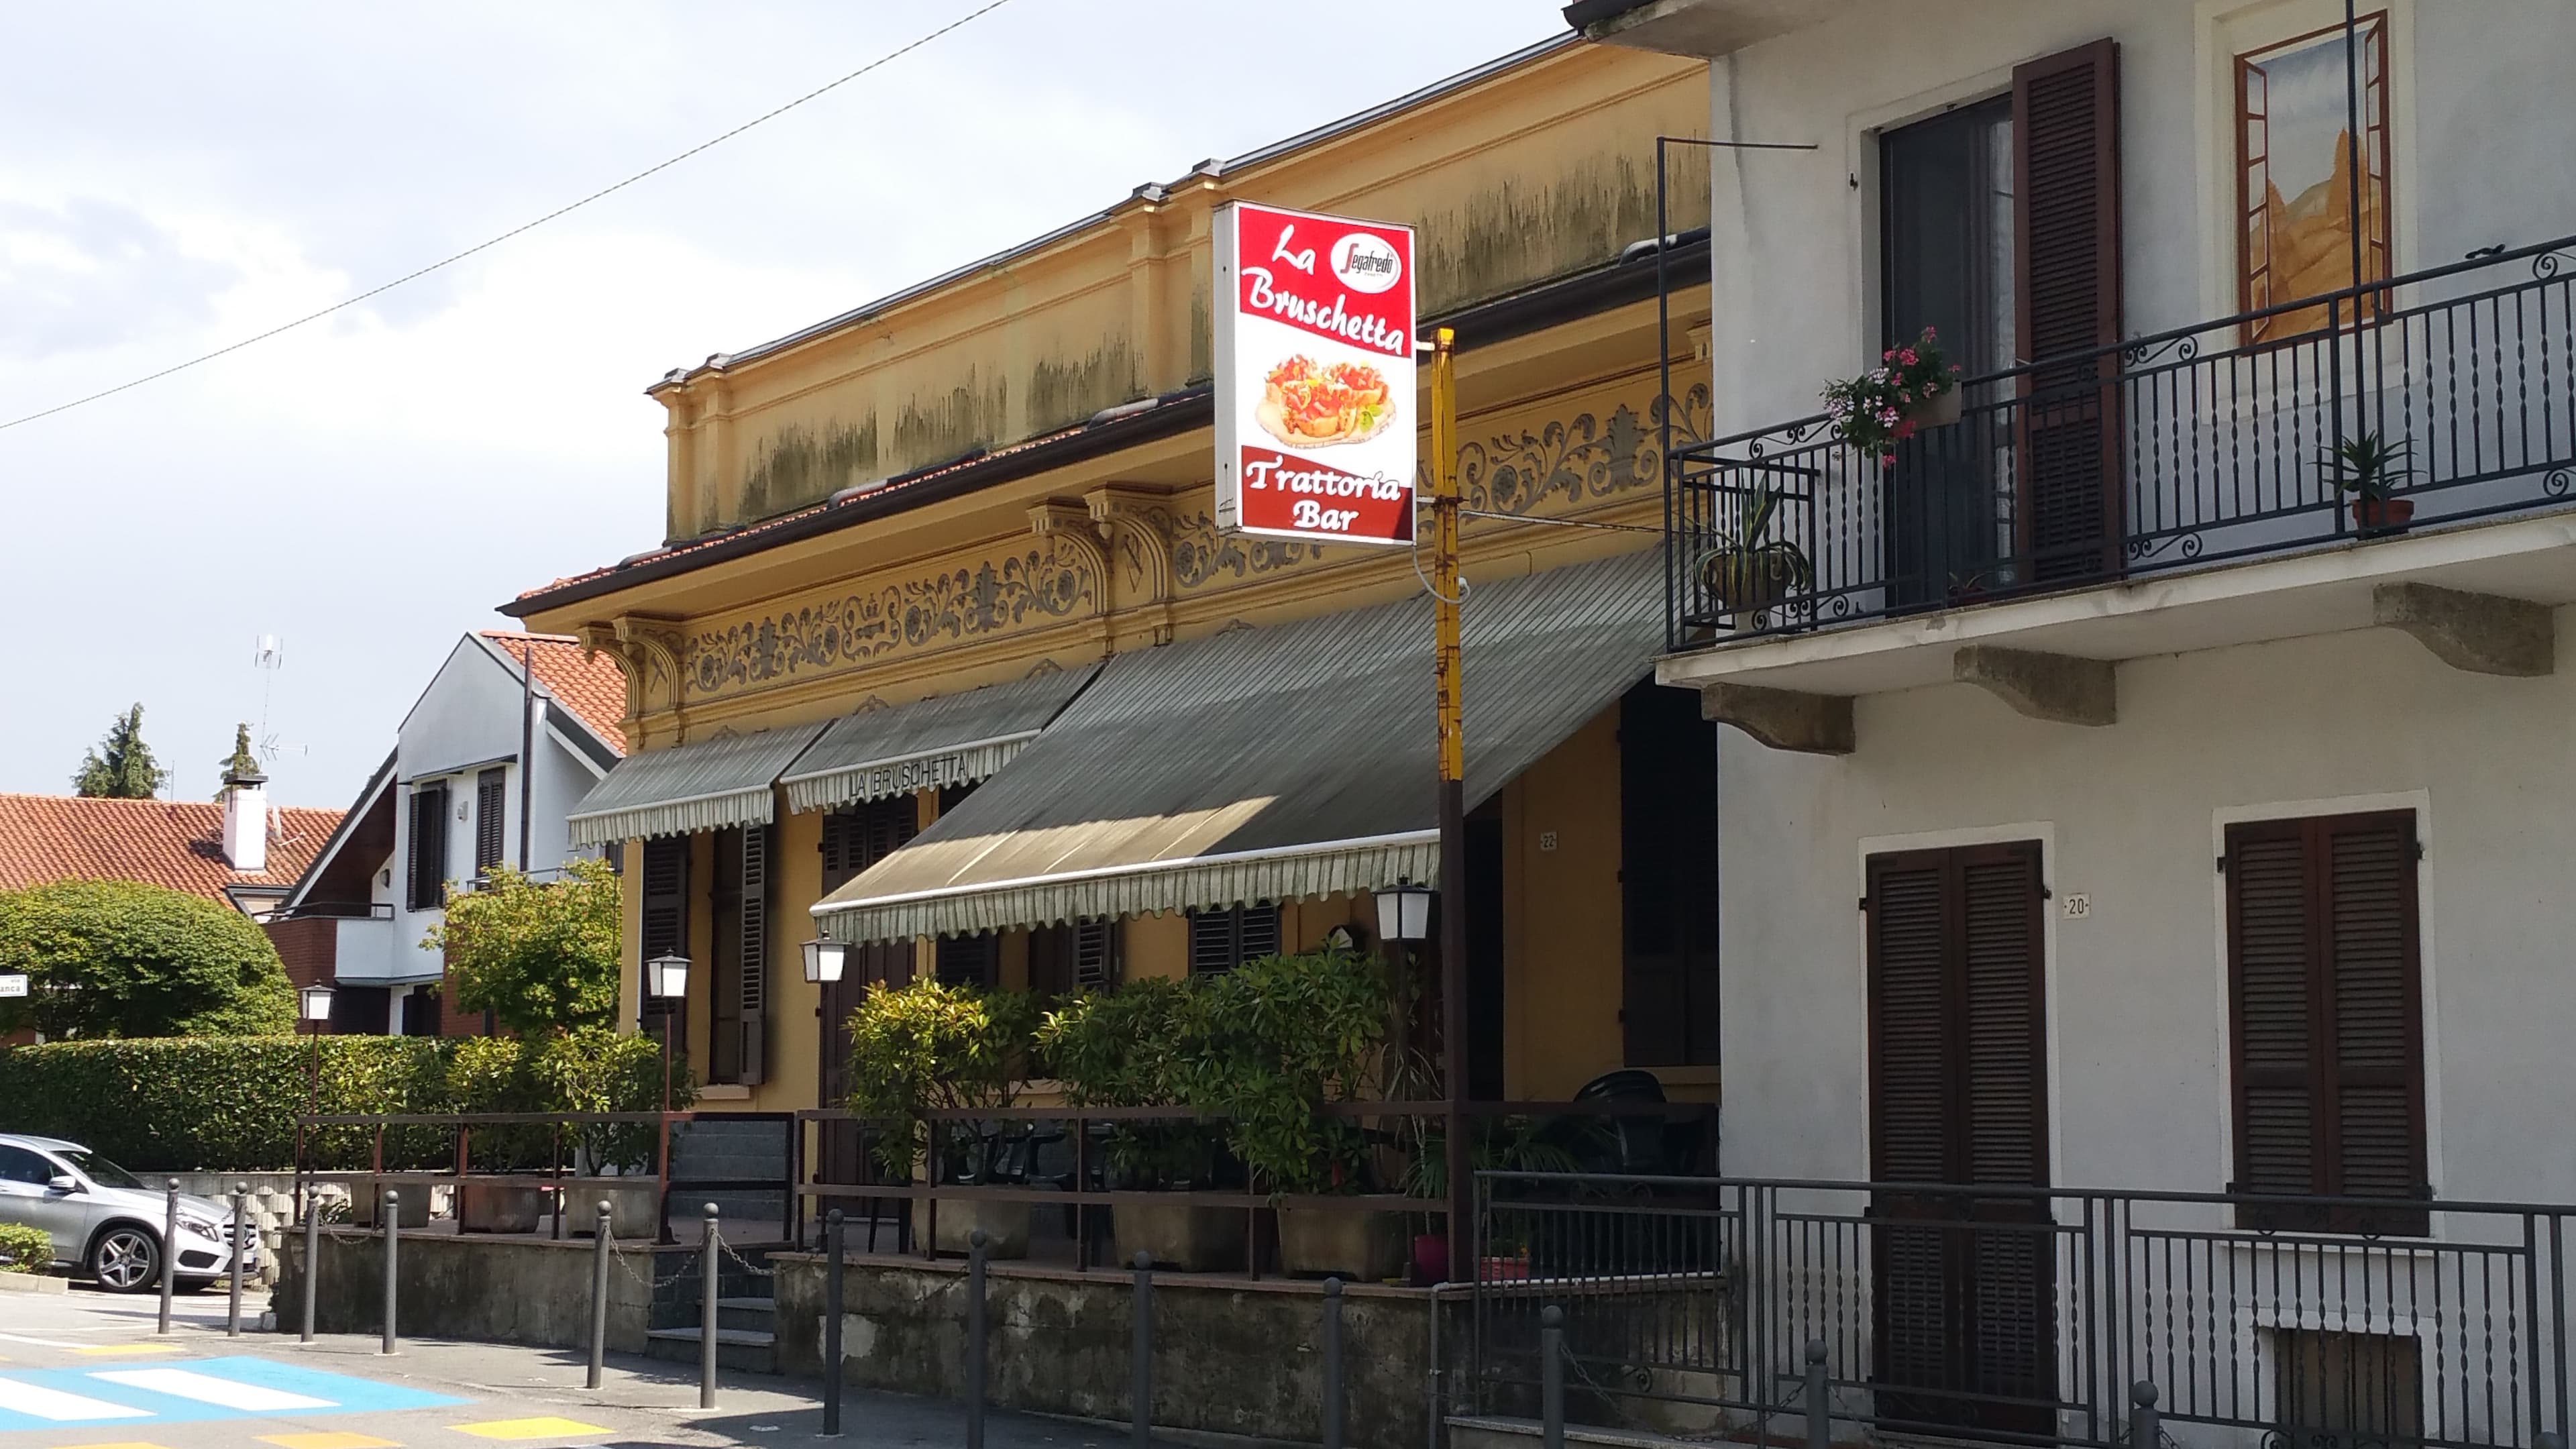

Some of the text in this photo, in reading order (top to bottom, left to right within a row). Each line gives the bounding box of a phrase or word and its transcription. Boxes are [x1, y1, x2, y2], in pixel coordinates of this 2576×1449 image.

[1272, 224, 1316, 276] La
[1340, 243, 1393, 274] Segafredo
[1241, 266, 1404, 356] Bruschetta
[1246, 455, 1401, 500] Trattoria
[1293, 500, 1359, 531] Bar
[850, 754, 966, 798] LA BRUSCHETTA
